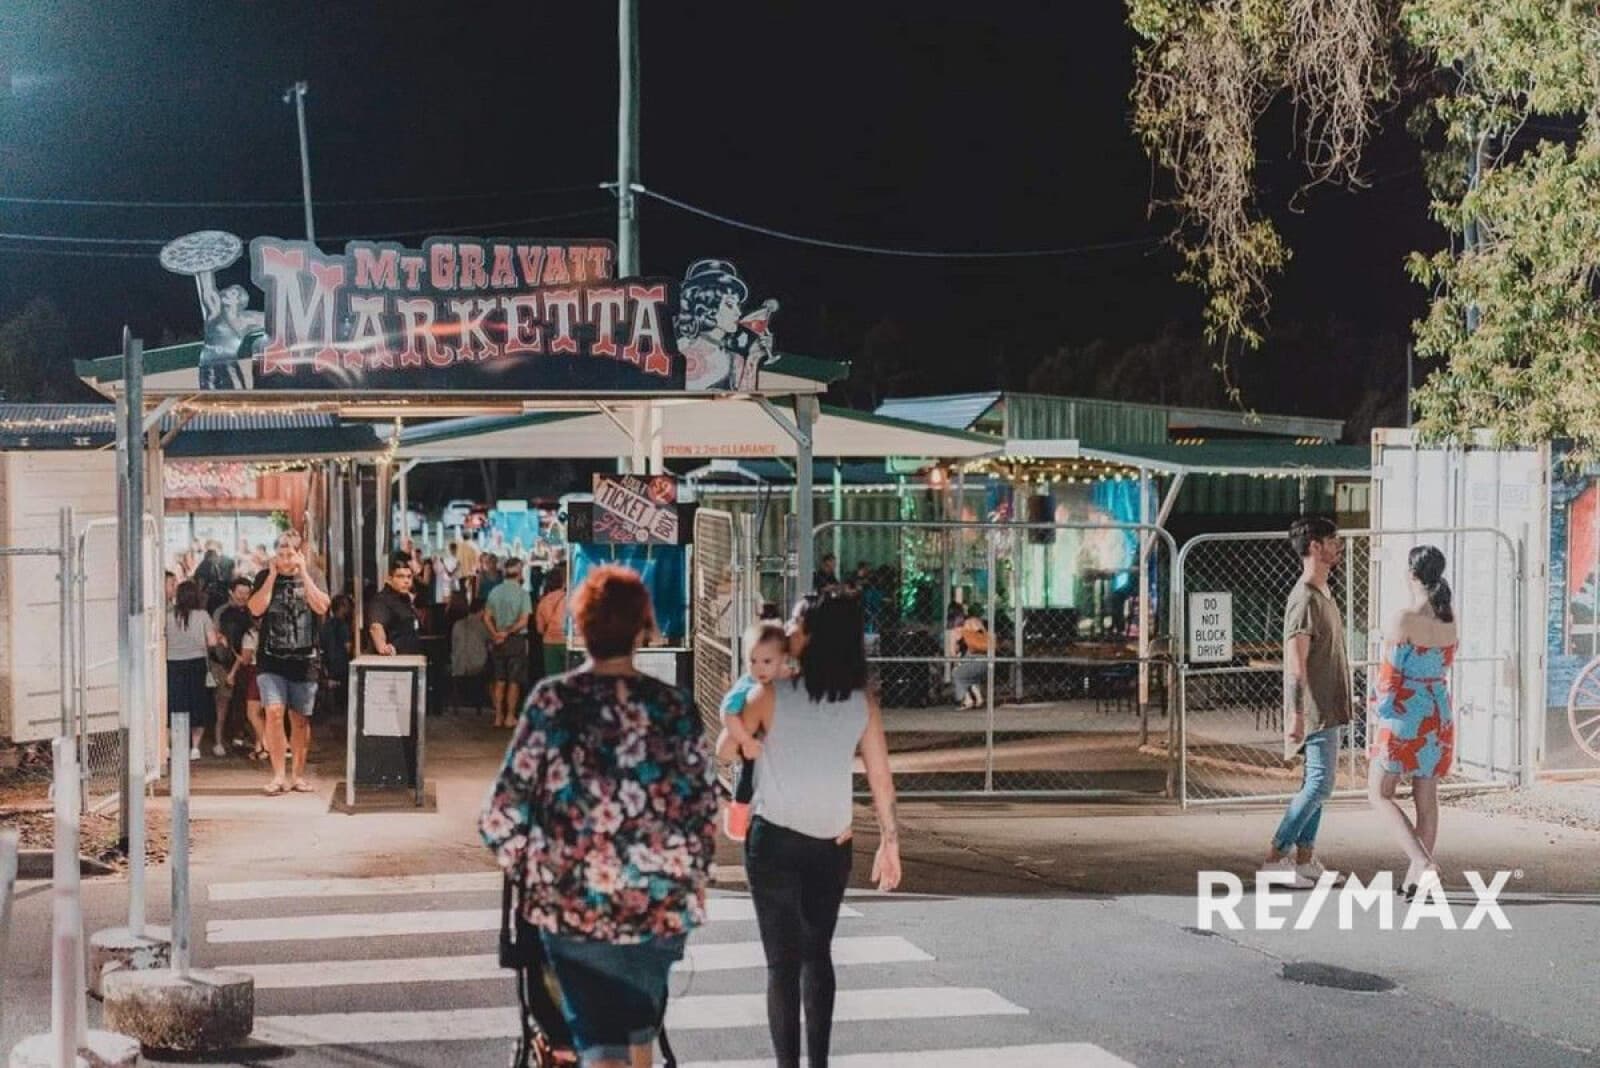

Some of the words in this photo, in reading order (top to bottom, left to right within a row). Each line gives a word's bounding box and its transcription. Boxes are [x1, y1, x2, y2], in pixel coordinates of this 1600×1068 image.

[429, 242, 612, 291] GRAVATT
[262, 246, 671, 376] MARKETTA
[663, 445, 691, 455] UTION
[720, 443, 776, 455] CLEARANCE
[600, 482, 650, 522] TICKET
[656, 512, 674, 539] BOX
[1203, 598, 1217, 610] DO
[1201, 613, 1219, 625] NOT
[1195, 629, 1227, 641] BLOCK
[1197, 644, 1225, 657] DRIVE
